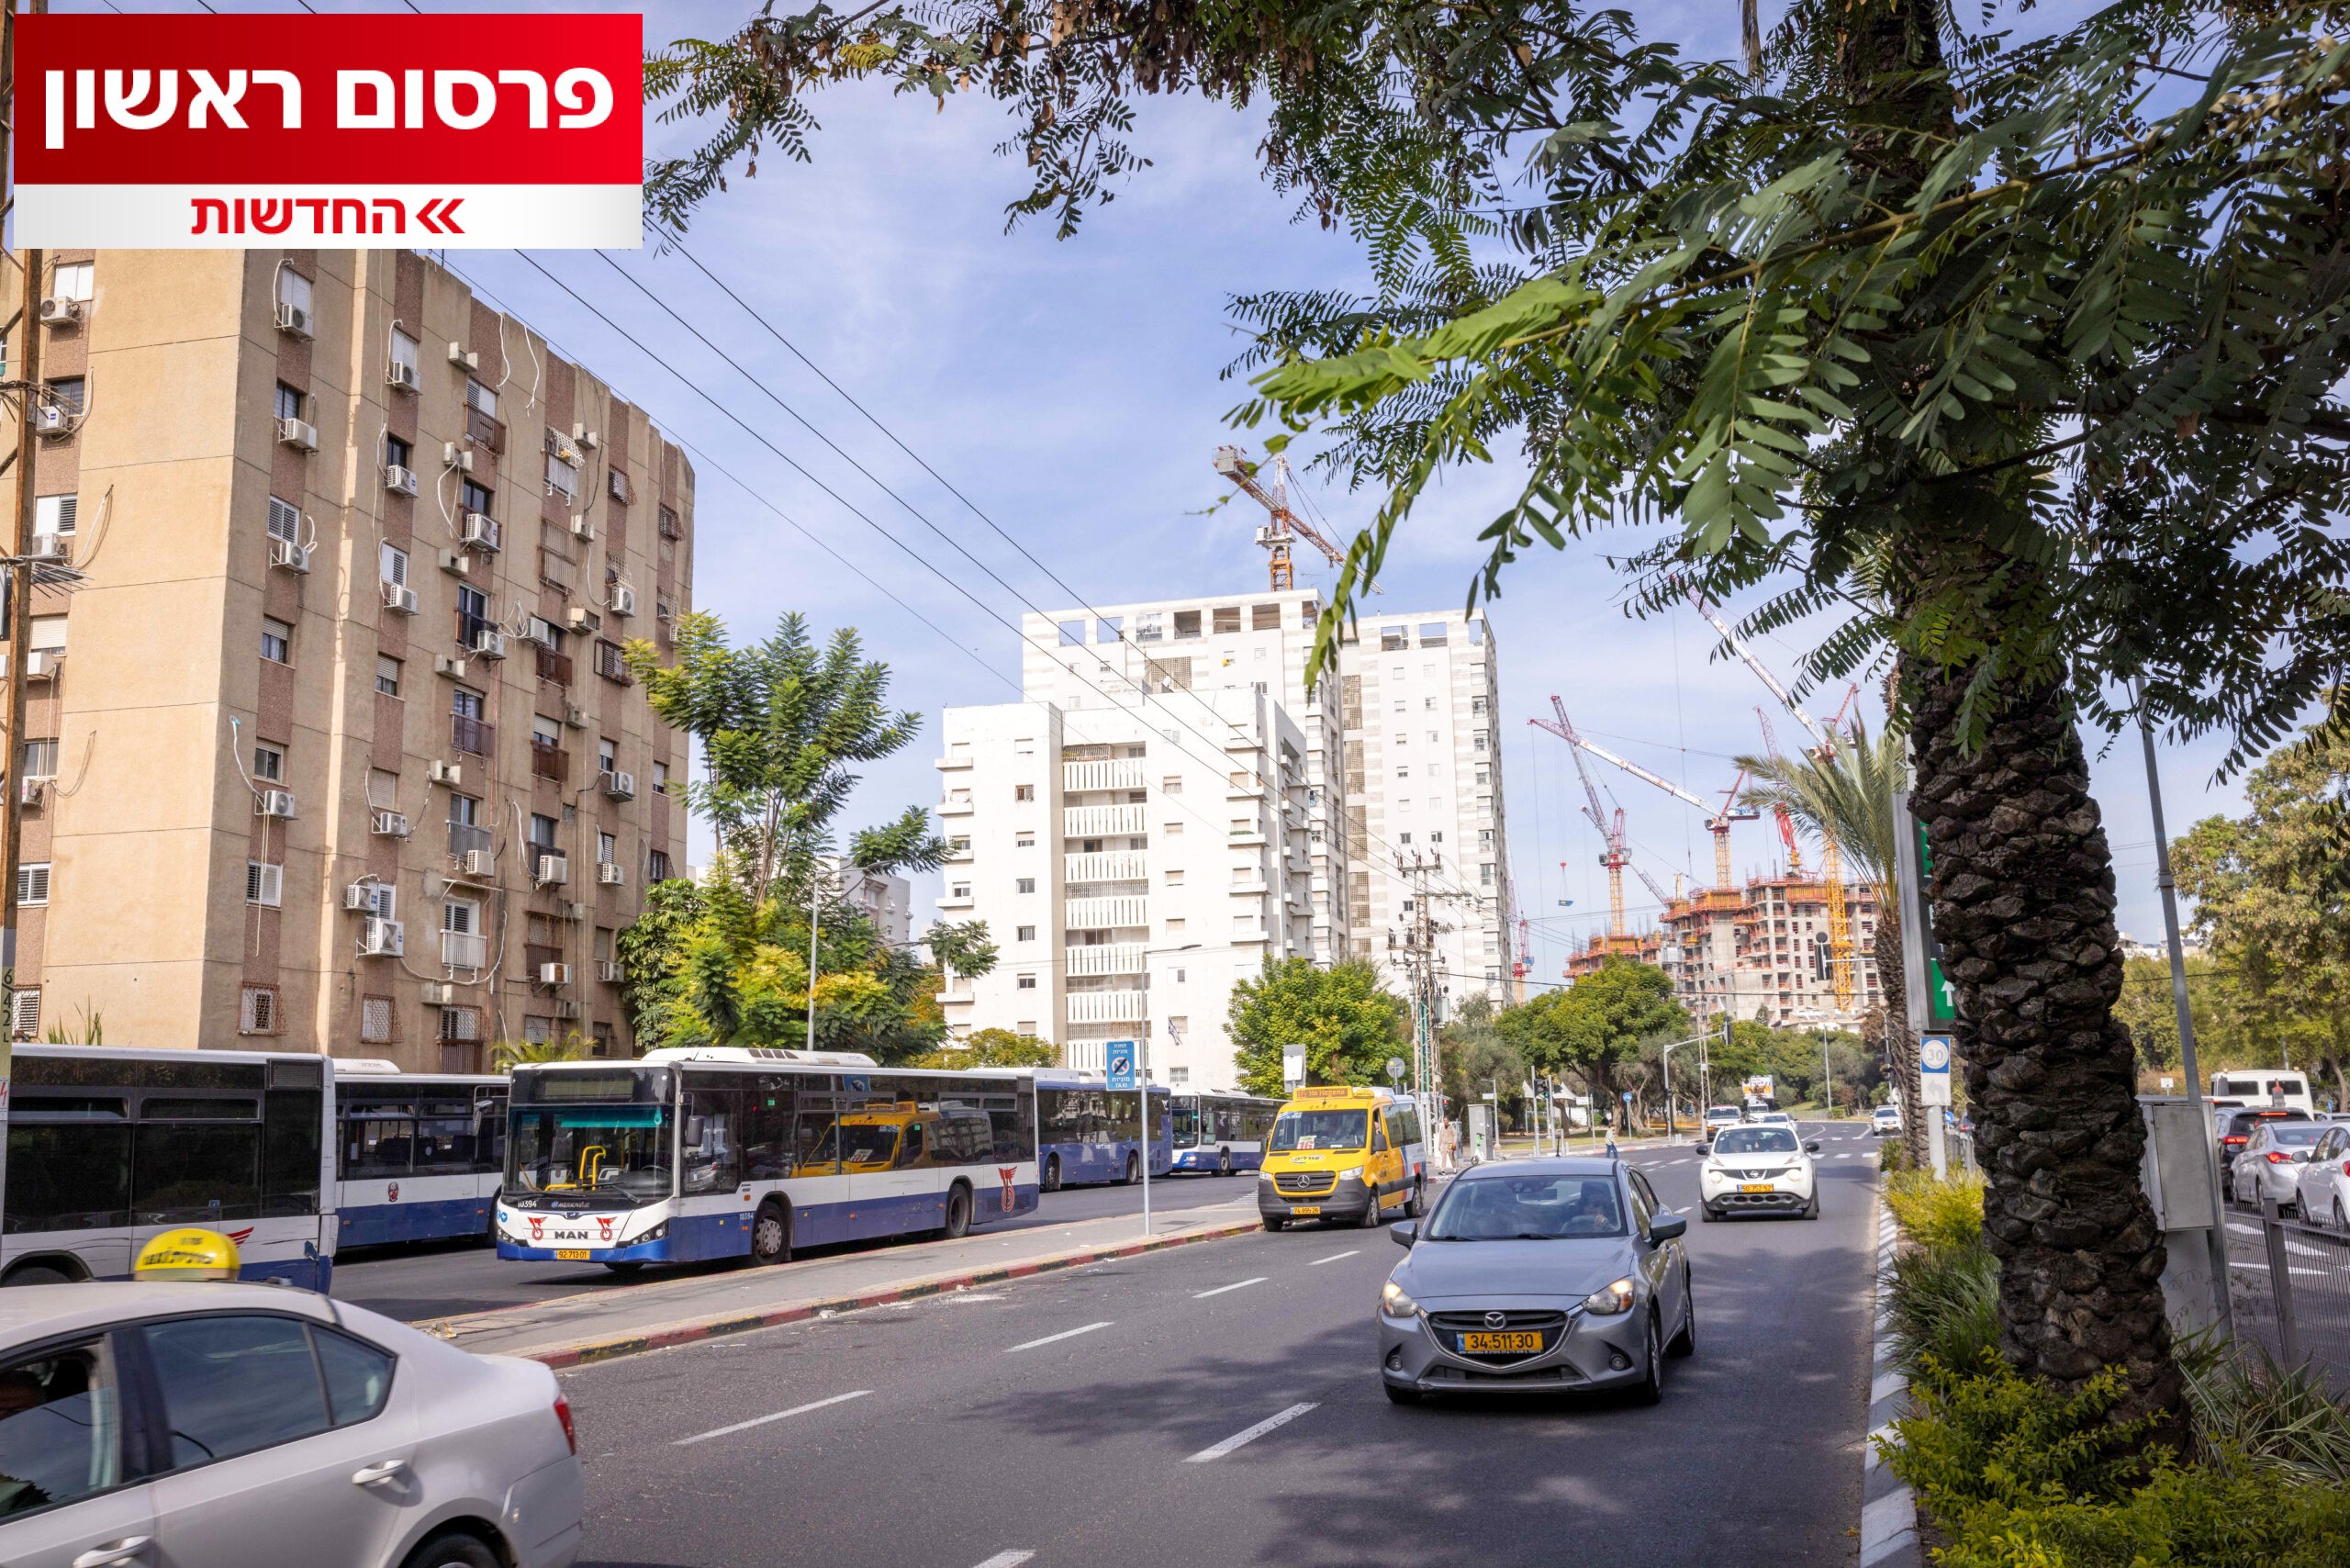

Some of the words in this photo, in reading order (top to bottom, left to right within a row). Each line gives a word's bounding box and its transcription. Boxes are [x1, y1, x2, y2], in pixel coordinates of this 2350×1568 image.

[1928, 1048, 1944, 1061] 30
[517, 1200, 537, 1208] 10394
[554, 1230, 588, 1239] MAN
